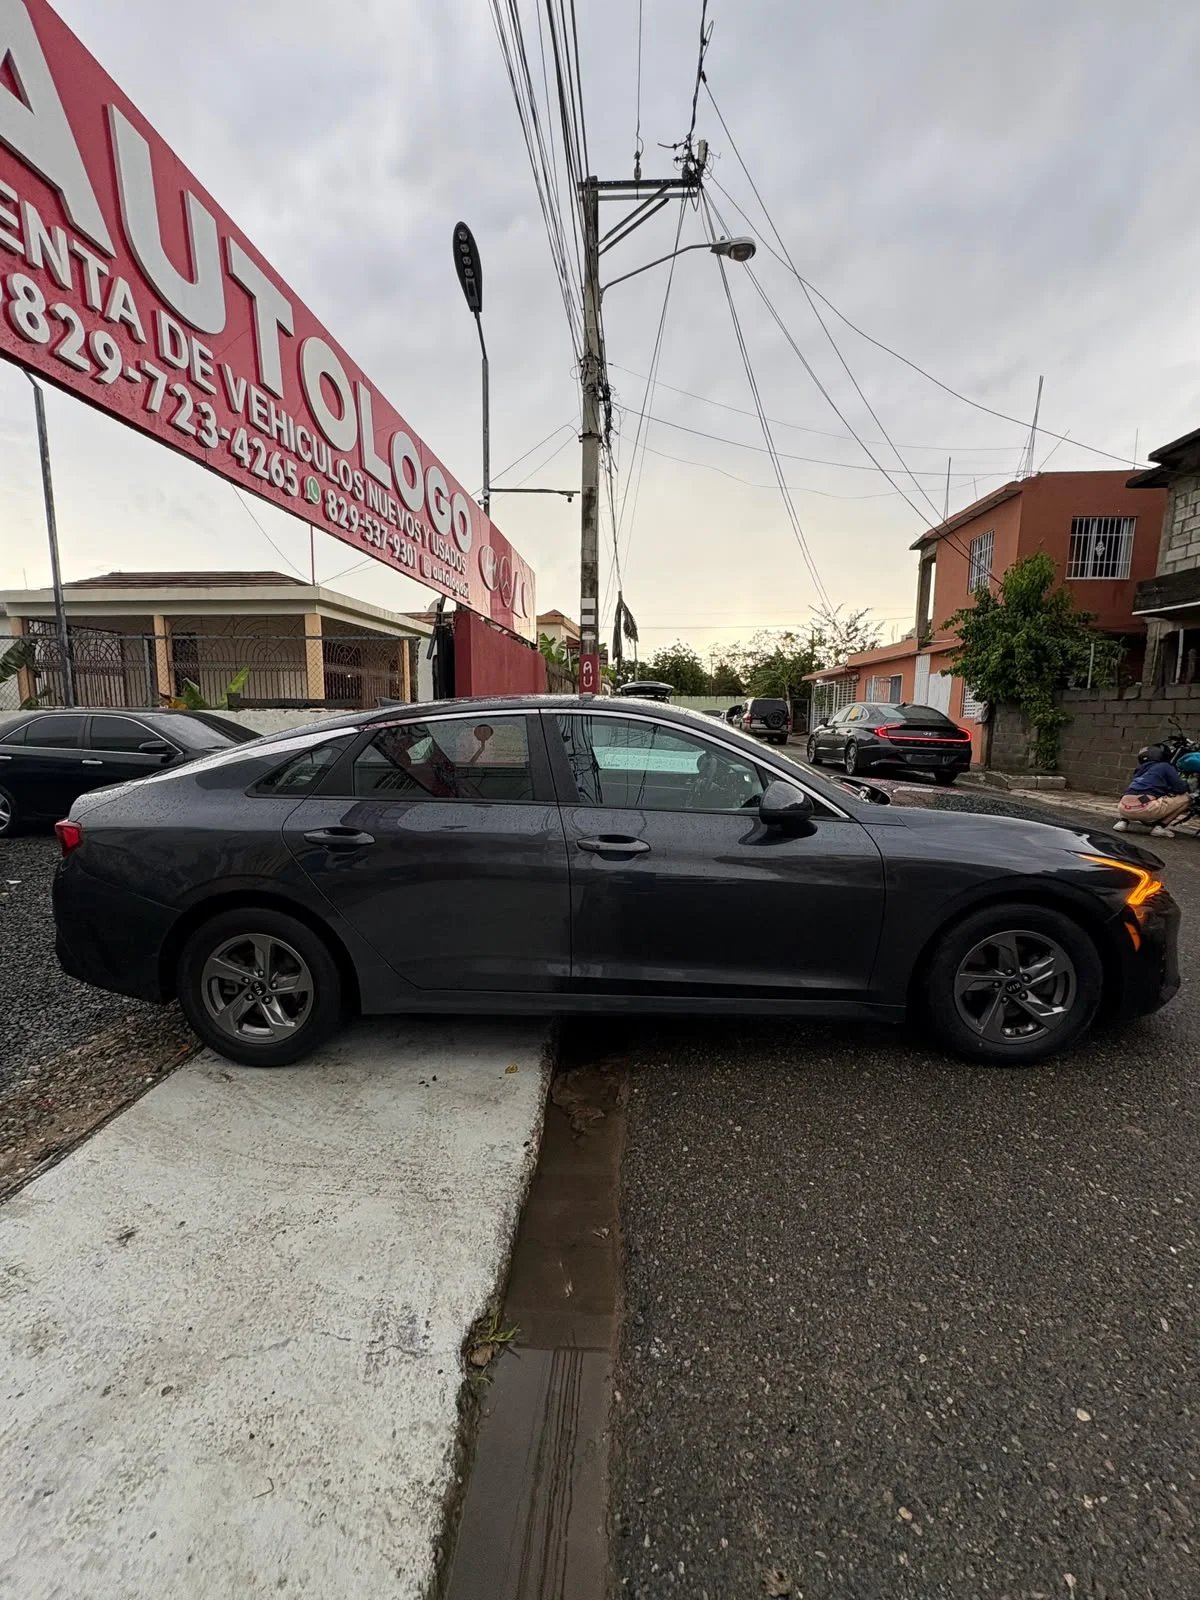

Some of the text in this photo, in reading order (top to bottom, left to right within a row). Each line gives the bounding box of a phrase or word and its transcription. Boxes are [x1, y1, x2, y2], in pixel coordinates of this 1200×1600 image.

[0, 0, 472, 553] AUTOLOGO
[7, 273, 299, 496] 829-723-4265
[326, 489, 417, 569] 829-537-9301
[157, 309, 217, 395] DE
[221, 363, 365, 501] VEHICULOS
[367, 481, 421, 542] NUEVOS
[424, 525, 430, 548] Y
[432, 533, 466, 575] USADOS
[583, 661, 593, 695] AU
